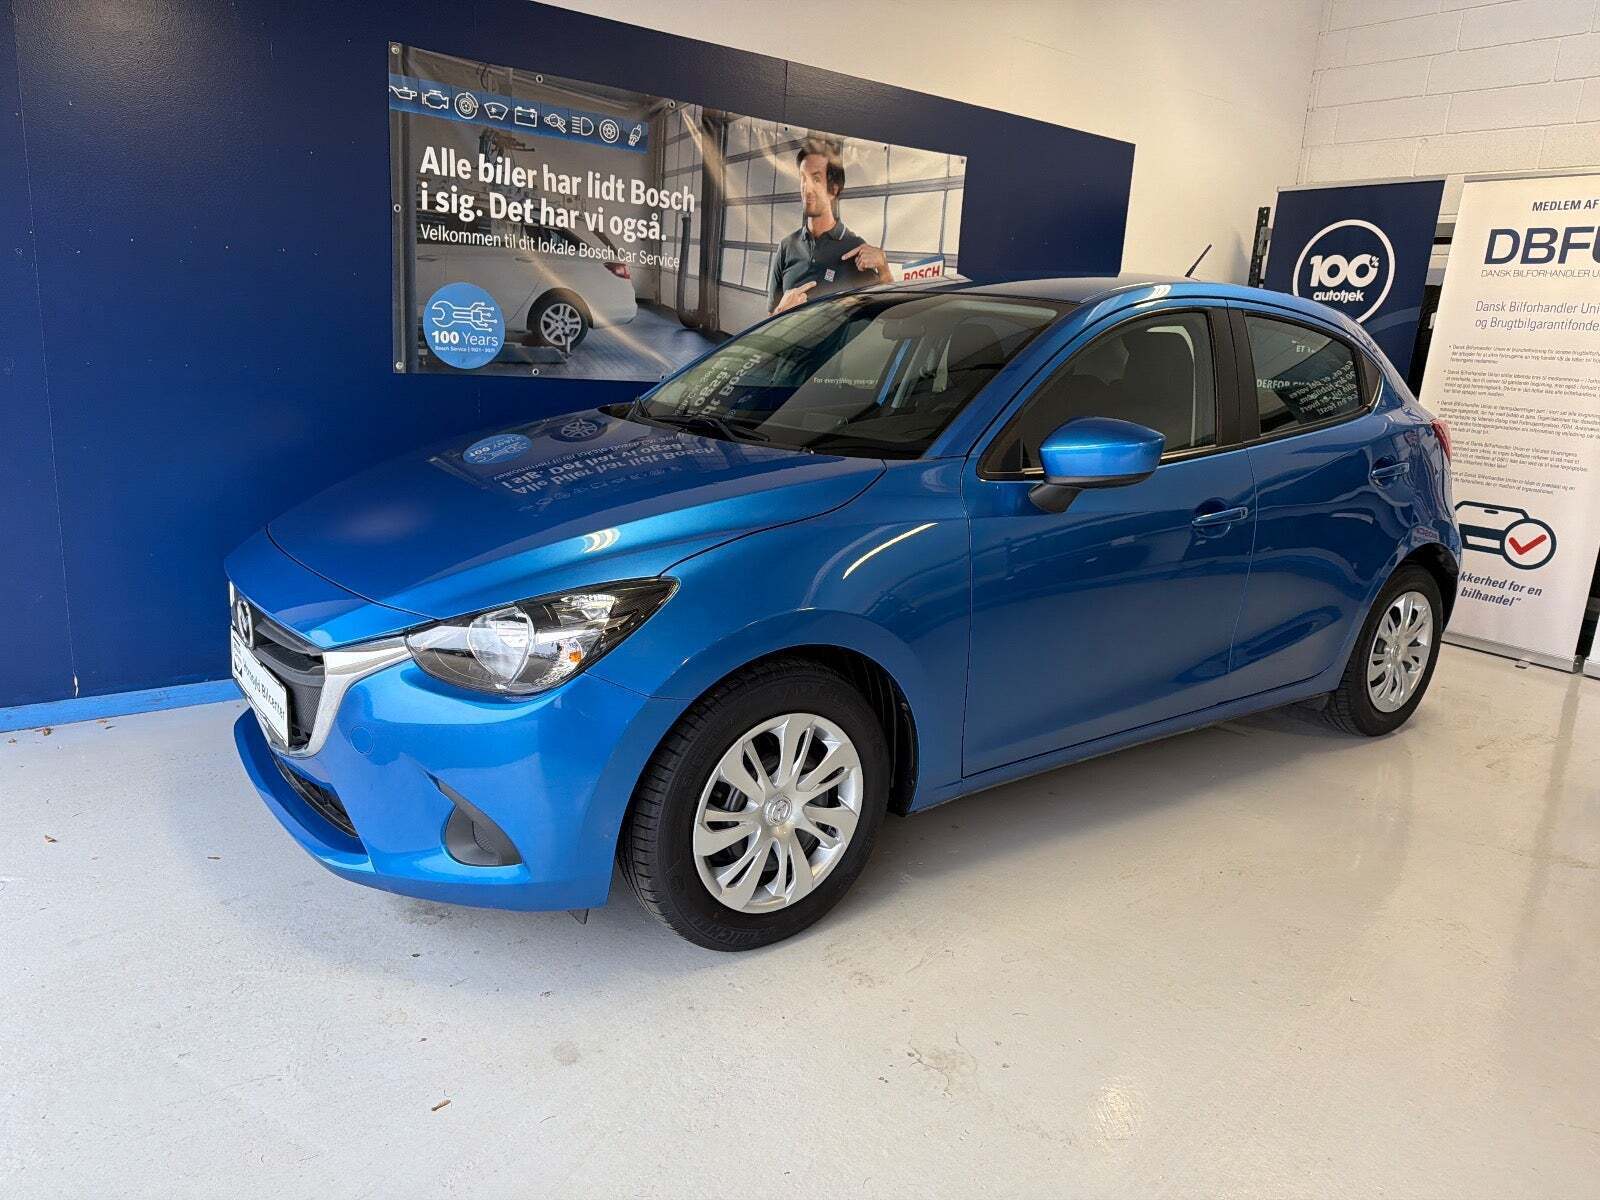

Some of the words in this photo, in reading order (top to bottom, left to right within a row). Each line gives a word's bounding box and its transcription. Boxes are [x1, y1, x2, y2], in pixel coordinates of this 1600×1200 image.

[420, 146, 472, 179] Alle
[479, 153, 537, 189] biler
[543, 163, 582, 196] har
[587, 171, 625, 203] lidt
[631, 179, 695, 212] Bosch
[421, 181, 428, 210] i
[435, 185, 483, 222] sig.
[489, 192, 534, 223] Det
[540, 198, 579, 229] har
[584, 206, 604, 232] vi
[610, 212, 667, 242] også.
[1532, 200, 1581, 212] MEDLEM
[1584, 199, 1600, 210] AF
[420, 223, 501, 247] Velkommen
[504, 233, 516, 249] til
[519, 236, 535, 252] dit
[538, 237, 576, 256] lokale
[579, 242, 614, 260] Bosch
[617, 247, 637, 262] Car
[640, 250, 680, 268] Service
[904, 265, 940, 280] BOSCH
[1481, 269, 1512, 278] DANSK
[1513, 269, 1591, 278] BILFORHANDLER
[1313, 289, 1365, 304] autotjek
[1475, 300, 1506, 312] Dansk
[1509, 300, 1578, 314] Bilforhandler
[1581, 302, 1600, 314] Uni
[1475, 319, 1488, 330] og
[432, 330, 460, 344] 100
[462, 331, 498, 347] Years
[1460, 571, 1507, 589] kkerhed
[1509, 581, 1526, 593] for
[1527, 587, 1543, 596] en
